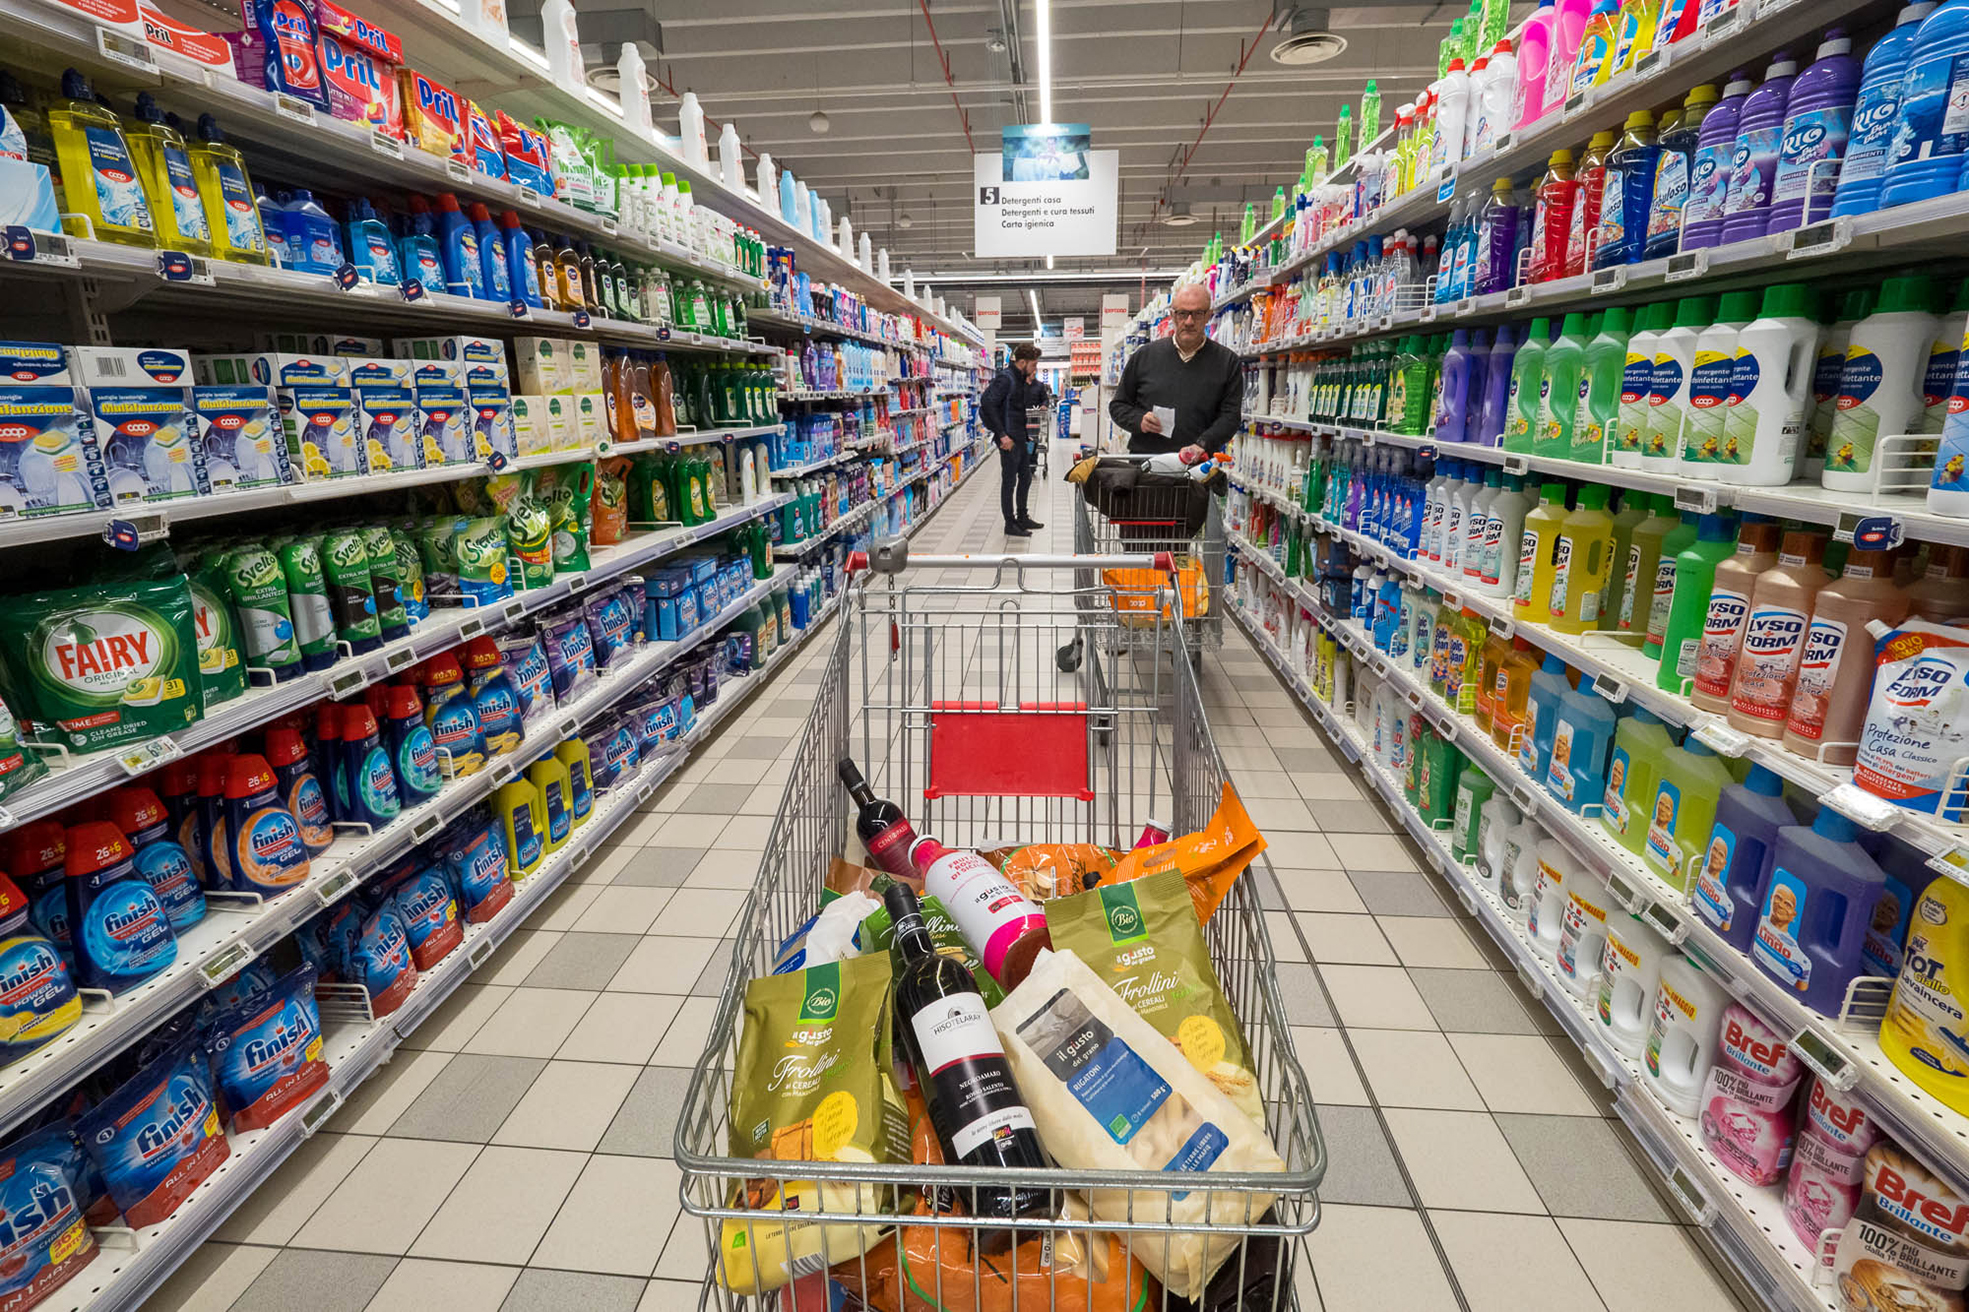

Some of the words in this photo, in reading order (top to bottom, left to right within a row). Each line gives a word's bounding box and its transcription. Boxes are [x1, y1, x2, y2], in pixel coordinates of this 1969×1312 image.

[146, 22, 172, 44] Pril
[276, 12, 310, 34] Pril
[356, 19, 389, 52] Pril
[323, 36, 380, 90] Pril
[417, 77, 459, 124] Pril
[1853, 103, 1896, 132] RIO
[1782, 128, 1822, 154] RIO
[108, 170, 127, 182] coop
[984, 188, 995, 204] 5
[1002, 196, 1042, 206] Detergenti
[1002, 209, 1042, 218] Detergenti
[1070, 206, 1094, 214] tessuti
[1002, 220, 1022, 228] Carta
[1025, 219, 1054, 230] igienica
[102, 402, 184, 414] Multifunzione
[200, 400, 268, 410] Multifunzione
[127, 423, 150, 433] coop
[221, 418, 240, 426] coop
[236, 555, 276, 590] Svelto
[256, 586, 276, 595] EXTRA
[600, 612, 629, 632] finish
[1749, 620, 1802, 633] LYSO
[1434, 638, 1448, 650] Span
[1435, 628, 1448, 640] Spic
[1745, 634, 1799, 648] FORM
[56, 631, 150, 680] FAIRY
[226, 650, 235, 660] 31
[561, 632, 591, 660] finish
[84, 668, 140, 684] ORIGINAL
[516, 654, 548, 684] finish
[1898, 667, 1952, 684] LYSO
[166, 681, 178, 690] 31
[1886, 683, 1943, 698] FORM
[430, 694, 450, 704] GEL
[90, 728, 120, 738] CLEANS
[123, 720, 148, 730] DRIED
[107, 728, 138, 740] GREASE
[434, 720, 474, 737] finish
[646, 714, 673, 735] finish
[1867, 723, 1931, 750] Protezione
[606, 738, 634, 763] finish
[1868, 738, 1896, 758] Casa
[1902, 750, 1938, 763] Classico
[248, 772, 270, 788] 26+6
[1879, 764, 1917, 782] allergeni
[1906, 766, 1932, 779] batteri
[252, 822, 294, 847] finish
[1650, 831, 1670, 853] Lindo
[96, 842, 122, 862] 26+6
[267, 850, 292, 862] POWER
[280, 848, 300, 862] GEL
[951, 871, 960, 880] DI
[160, 882, 188, 899] POWER
[174, 884, 197, 900] GEL
[402, 880, 447, 920] finish
[980, 885, 1008, 901] gusto
[1699, 880, 1720, 903] Lindo
[1584, 901, 1606, 923] OMAGGIO
[1925, 896, 1946, 911] NUOVO
[104, 896, 158, 933] finish
[1115, 910, 1134, 925] Bio
[126, 923, 158, 944] POWER
[142, 926, 168, 945] GEL
[1759, 929, 1791, 958] Lindo
[1122, 946, 1154, 966] gusto
[1616, 943, 1639, 966] OMAGGIO
[1112, 971, 1179, 1000] Frollini
[1914, 971, 1950, 995] Giallo
[14, 983, 52, 1008] POWER
[33, 984, 66, 1008] GEL
[811, 996, 831, 1007] Bio
[1138, 995, 1165, 1008] CEREALI
[1670, 987, 1696, 1018] OMAGGIO
[1902, 971, 1963, 1020] Lavaincera
[245, 1014, 314, 1074] finish
[798, 1028, 832, 1043] gusto
[1725, 1019, 1787, 1068] Bref
[1056, 1052, 1067, 1064] il
[1067, 1030, 1094, 1056] gusto
[1072, 1058, 1083, 1068] del
[1083, 1042, 1099, 1061] grano
[768, 1048, 841, 1092] Frollini
[1726, 1044, 1770, 1075] Brillante
[265, 1084, 284, 1101] ALL
[284, 1076, 294, 1091] IN
[301, 1063, 317, 1080] MAX
[792, 1076, 821, 1090] CEREALI
[959, 1070, 1001, 1090] NEGROAMARO
[983, 1082, 1004, 1092] SALENTO
[1073, 1064, 1102, 1092] RIGATONI
[1714, 1069, 1737, 1089] 100%
[1151, 1088, 1161, 1100] 500
[1734, 1093, 1760, 1107] passata
[1736, 1087, 1774, 1104] BRILLANTE
[1810, 1078, 1864, 1135] Bref
[134, 1086, 206, 1158] finish
[1810, 1106, 1846, 1141] Brillante
[1187, 1147, 1200, 1163] TERRE
[1200, 1132, 1213, 1149] LIBERE
[1198, 1144, 1212, 1160] MAFIE
[165, 1171, 184, 1188] ALL
[185, 1161, 196, 1175] IN
[201, 1137, 218, 1157] MAX
[1813, 1152, 1850, 1176] BRILLANTE
[1875, 1163, 1969, 1235] Bref
[1879, 1196, 1952, 1243] Brillante
[38, 1215, 77, 1250] CHARGED
[1858, 1224, 1900, 1257] 100%
[1902, 1243, 1919, 1257] PIÙ
[1864, 1244, 1885, 1260] dalla
[1896, 1260, 1937, 1281] passata
[1899, 1252, 1958, 1280] BRILLANTE
[3, 1292, 24, 1312] IN
[38, 1258, 73, 1288] MAX
